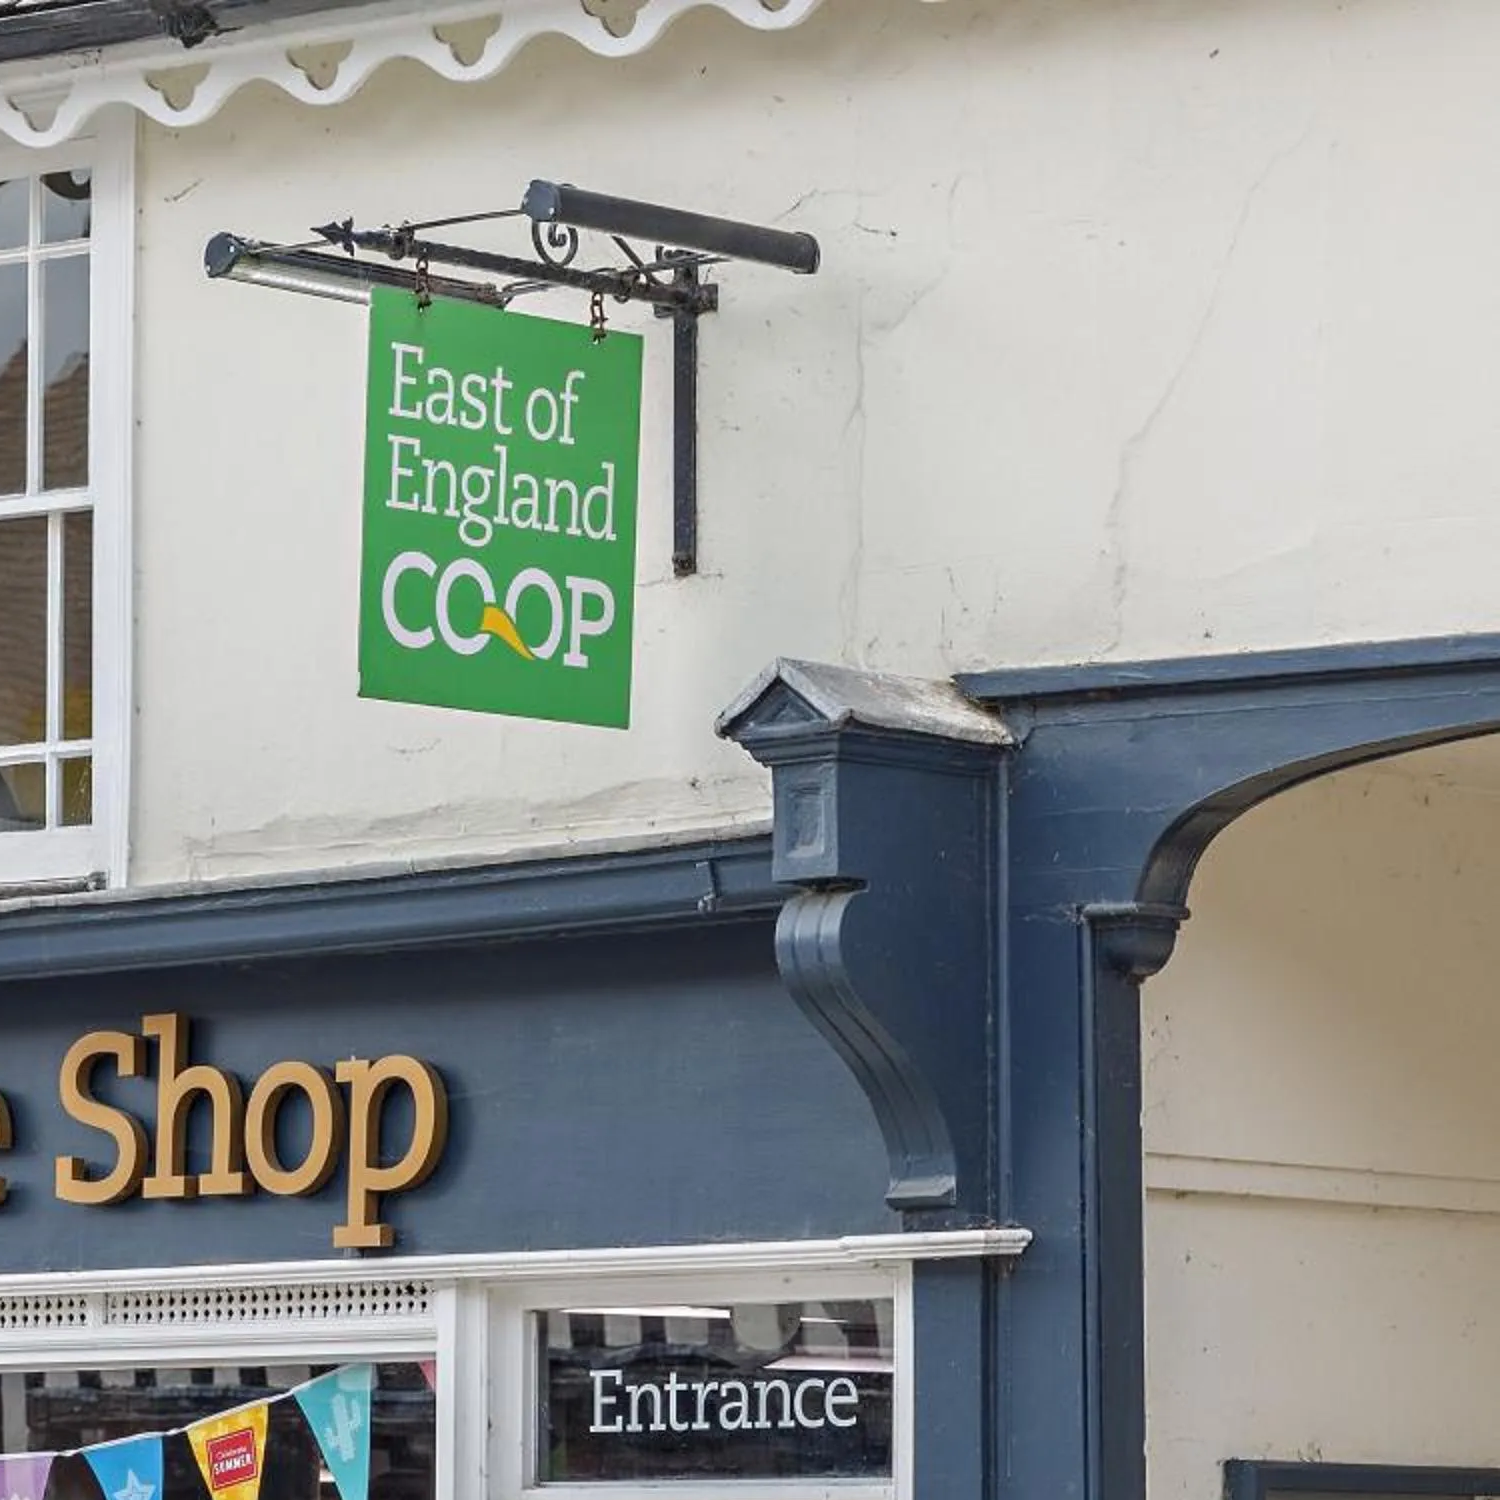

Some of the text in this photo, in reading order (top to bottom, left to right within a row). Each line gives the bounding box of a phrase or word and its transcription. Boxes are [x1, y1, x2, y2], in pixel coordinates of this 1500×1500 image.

[388, 342, 585, 445] East of
[385, 434, 617, 548] England
[381, 550, 617, 669] COOP
[54, 1012, 449, 1250] Shop
[589, 1368, 860, 1433] Entrance
[213, 1453, 252, 1475] SUMMER
